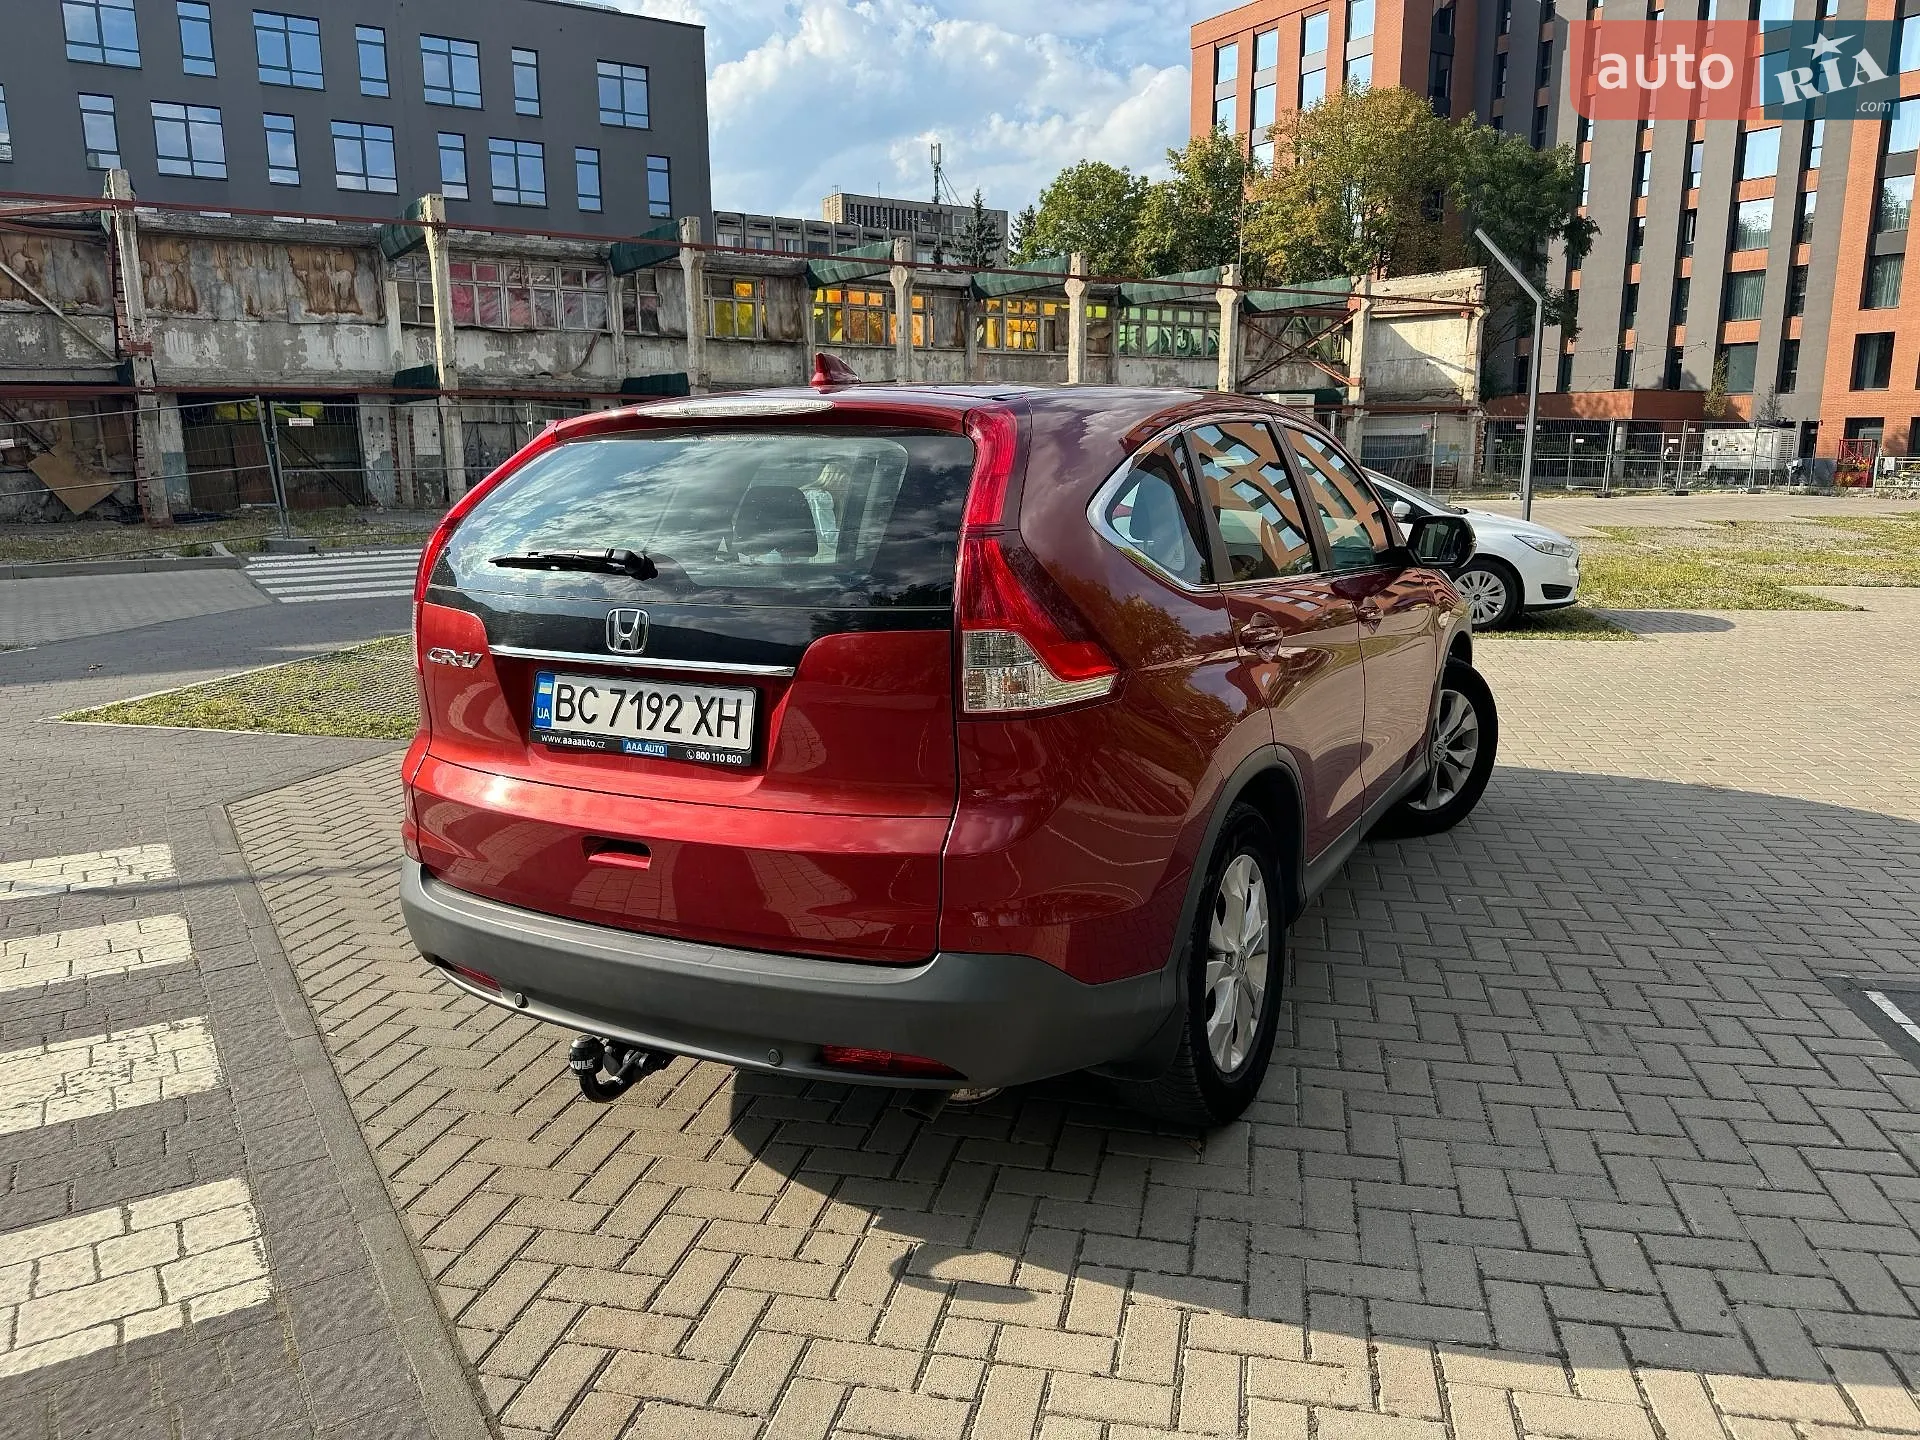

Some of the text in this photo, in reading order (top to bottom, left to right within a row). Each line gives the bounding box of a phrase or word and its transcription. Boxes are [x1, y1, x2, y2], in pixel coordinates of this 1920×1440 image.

[427, 647, 484, 668] CR-V
[537, 706, 551, 719] UA
[555, 683, 742, 739] BC 7192 XH
[541, 734, 606, 749] www.aaaauto.cz
[626, 741, 665, 753] AAA AUTO
[695, 751, 742, 764] 800 110 800
[570, 1059, 594, 1070] ULE
